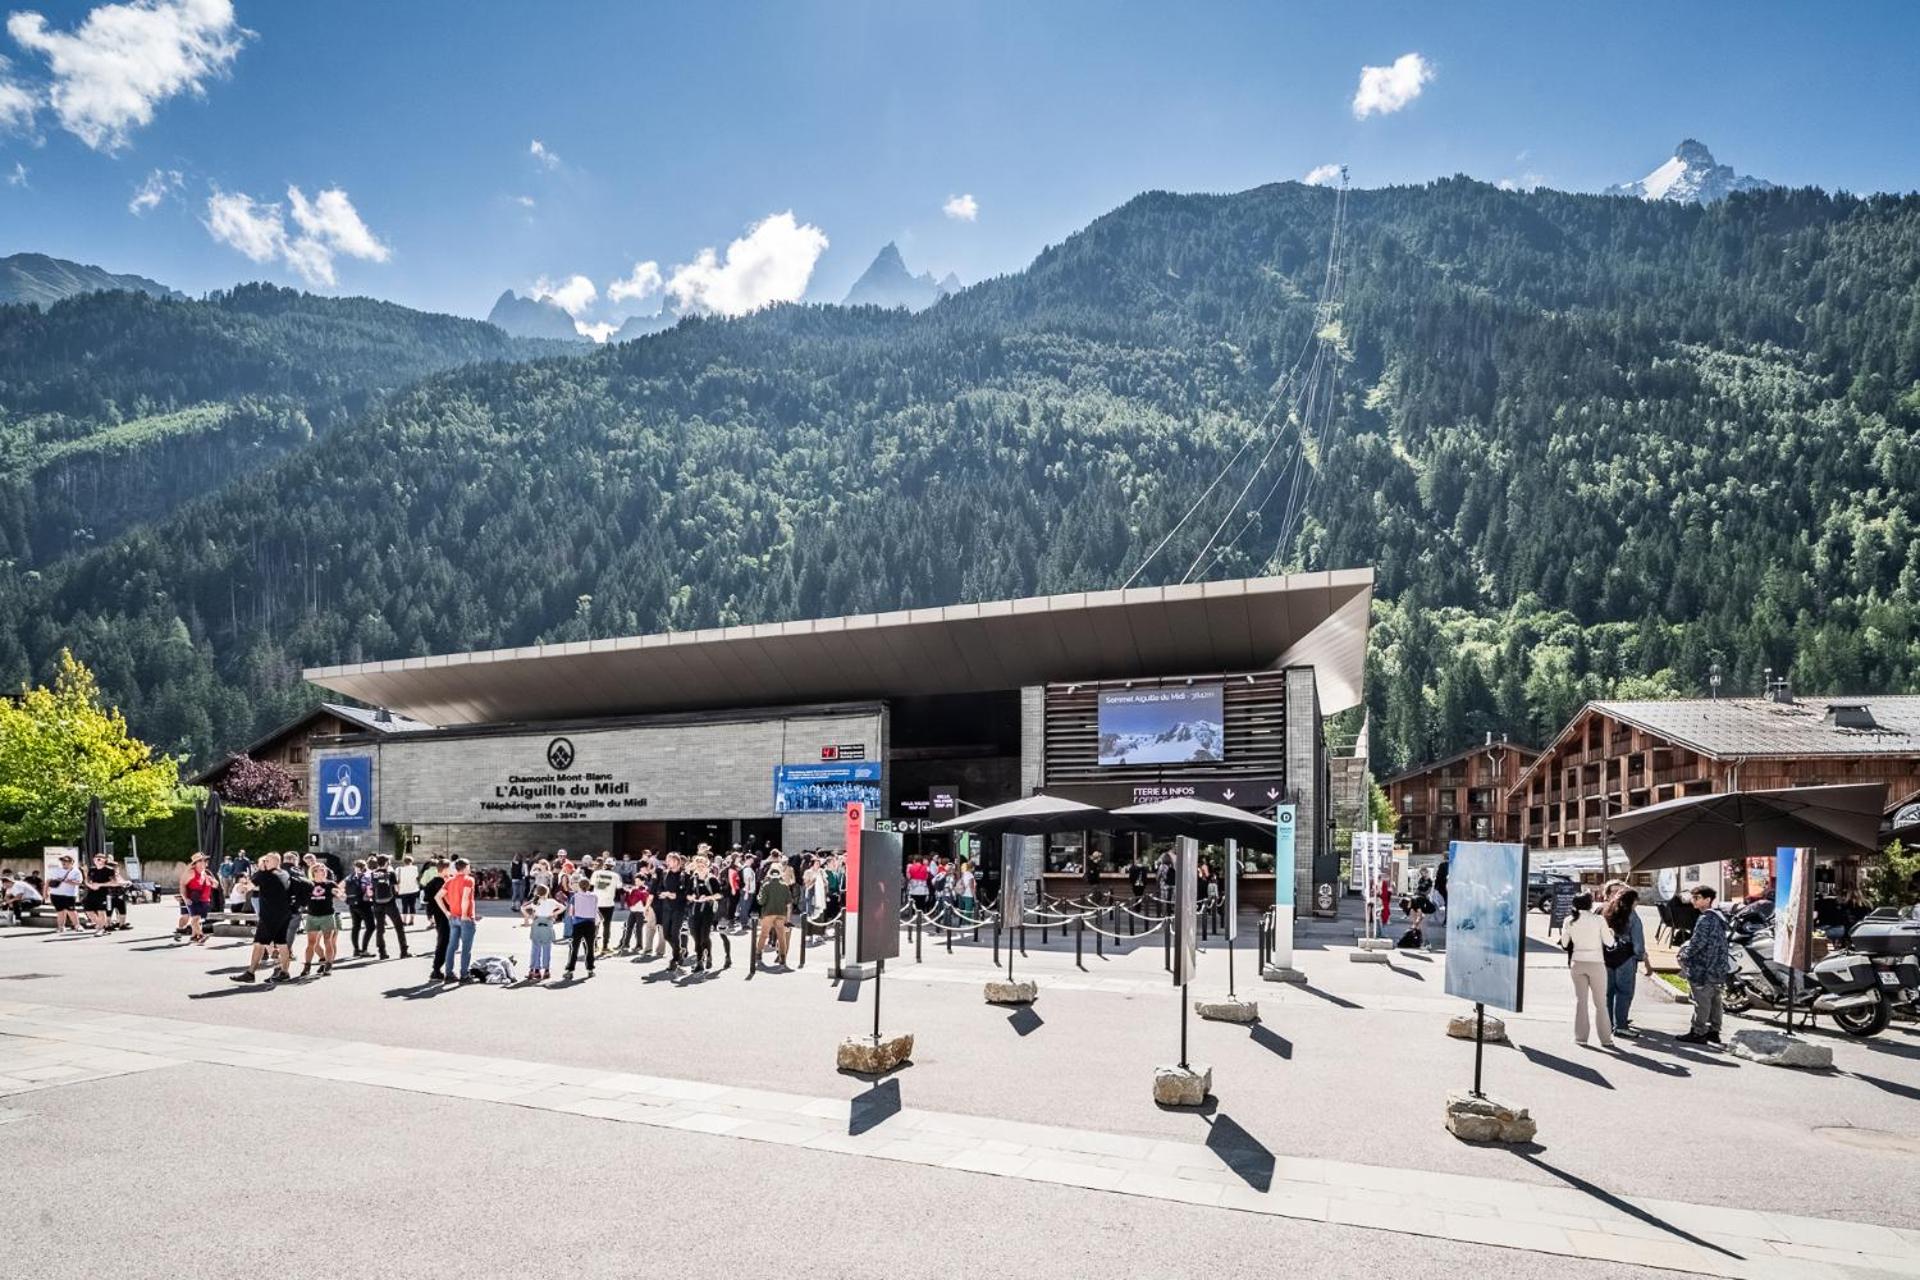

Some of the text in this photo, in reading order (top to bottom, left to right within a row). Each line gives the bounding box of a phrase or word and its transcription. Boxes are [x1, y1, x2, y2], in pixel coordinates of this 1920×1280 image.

[1171, 692, 1186, 700] Midi
[508, 775, 555, 783] Chamonix
[496, 782, 629, 799] L'Aiguille du Midi
[1161, 787, 1168, 795] &
[1169, 786, 1195, 796] INFOS
[327, 785, 362, 816] 70
[480, 798, 648, 811] Téléphérique de l'Aiguille du Midi
